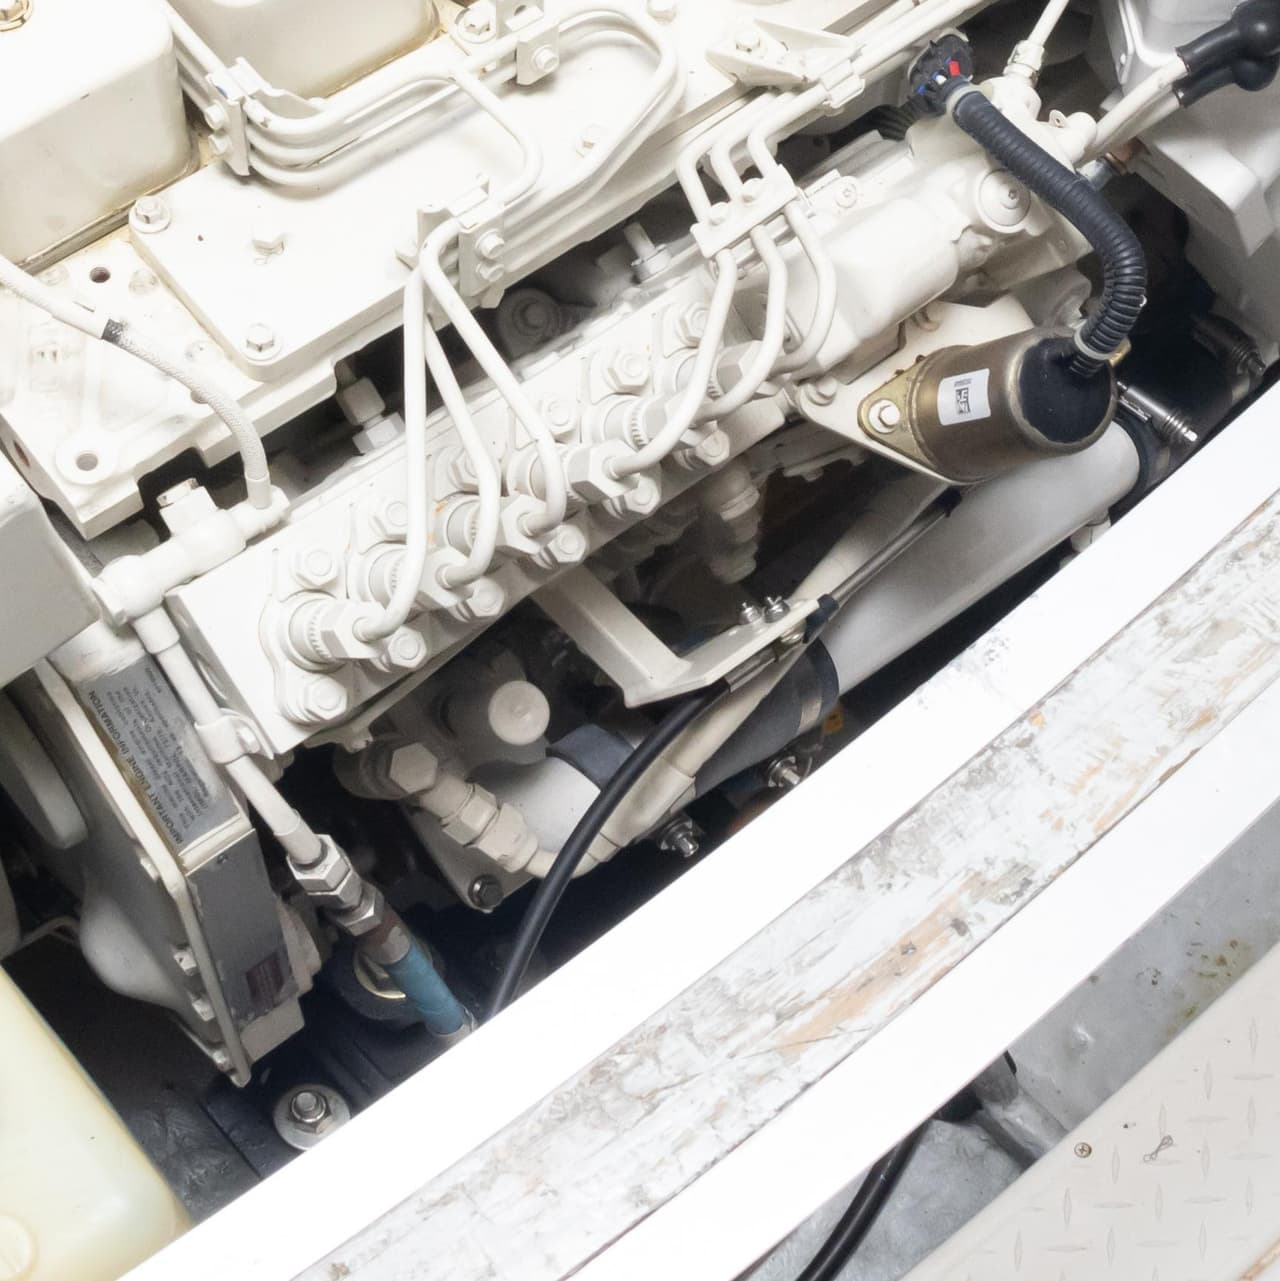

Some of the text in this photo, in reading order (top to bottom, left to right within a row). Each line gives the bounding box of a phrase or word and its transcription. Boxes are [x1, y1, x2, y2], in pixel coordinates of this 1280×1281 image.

[87, 690, 130, 756] INFORMATION
[125, 754, 151, 792] ENGINE
[147, 792, 184, 845] IMPORTANT
